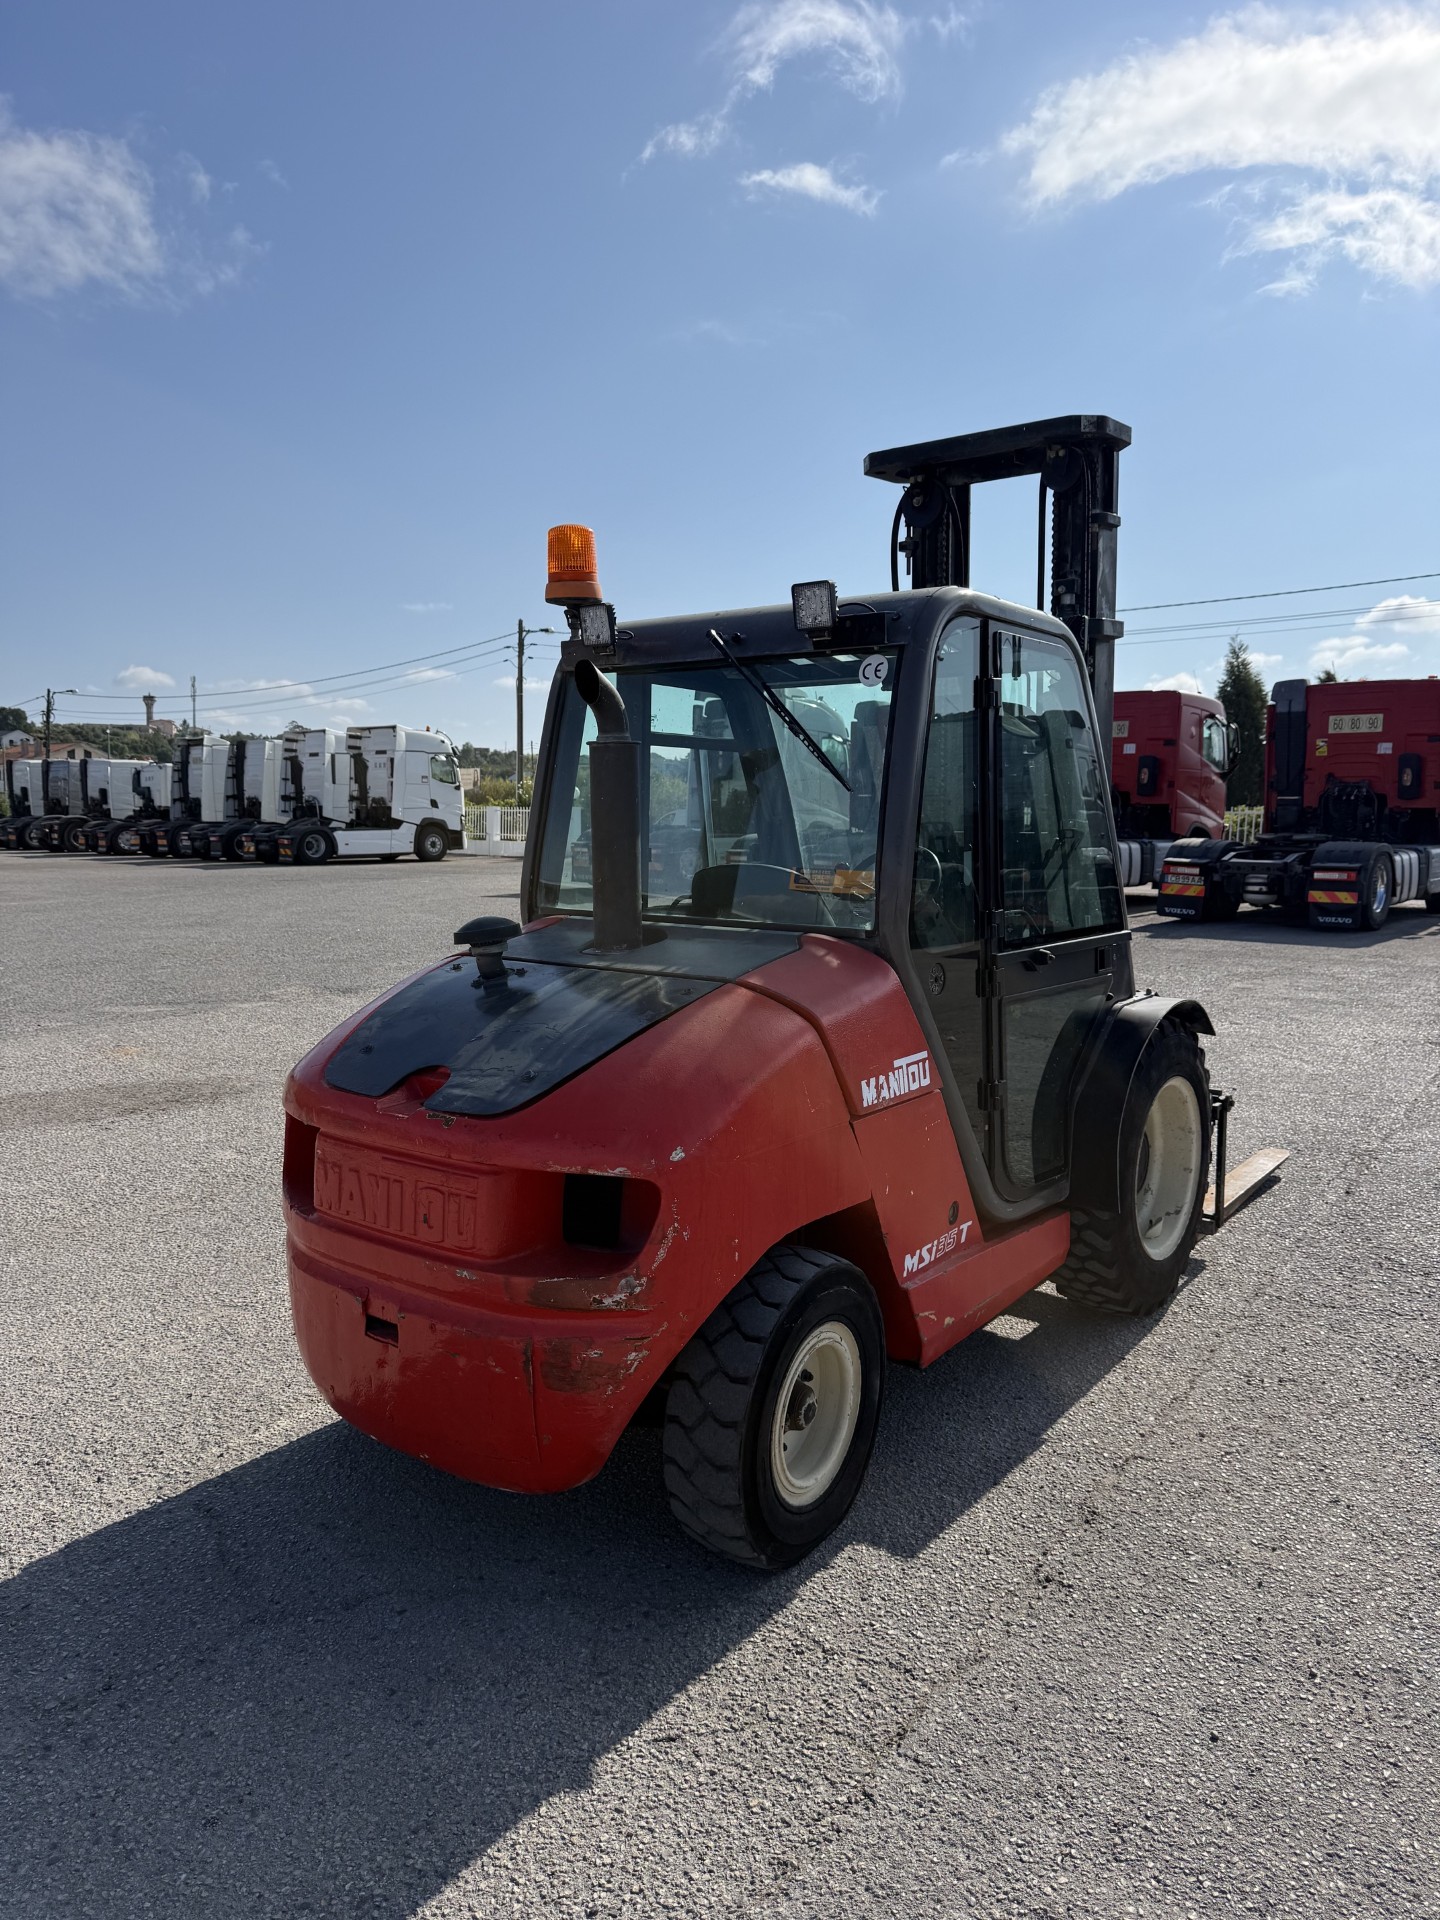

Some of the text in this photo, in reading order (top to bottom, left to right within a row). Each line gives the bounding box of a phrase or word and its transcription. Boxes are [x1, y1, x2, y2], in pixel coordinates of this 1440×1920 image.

[862, 661, 884, 680] CE
[1116, 723, 1126, 735] 90
[1333, 717, 1379, 731] 60 80 90
[1164, 907, 1196, 916] VOLVO
[1317, 916, 1353, 924] VOLVO
[860, 1050, 931, 1108] MANITOU
[316, 1155, 479, 1251] MANITOU
